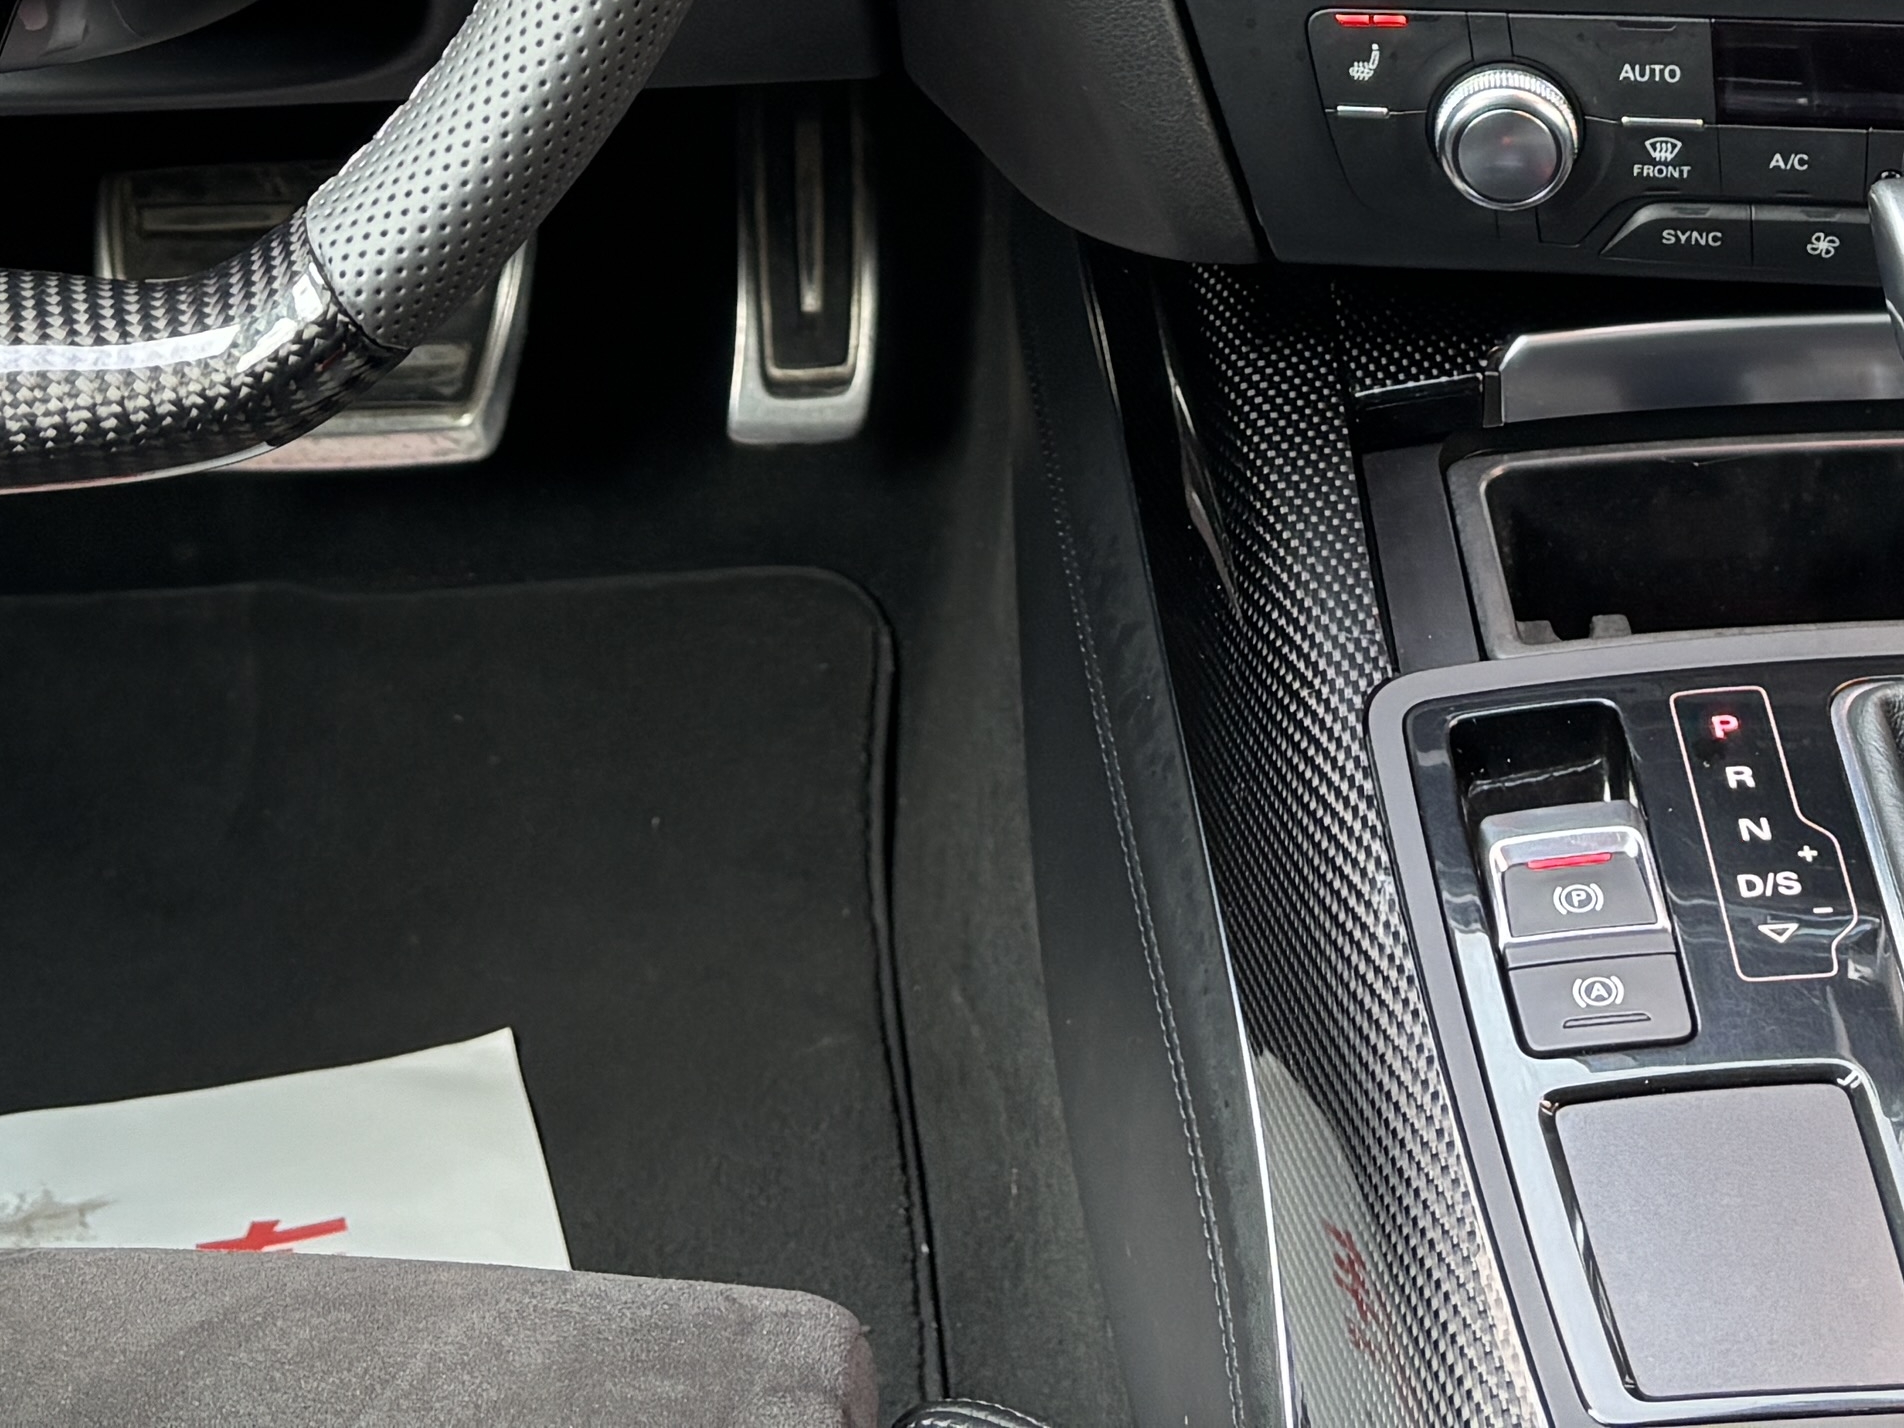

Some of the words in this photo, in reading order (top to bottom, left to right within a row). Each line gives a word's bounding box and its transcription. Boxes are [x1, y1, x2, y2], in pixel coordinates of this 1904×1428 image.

[1618, 63, 1681, 84] AUTO
[1632, 163, 1691, 179] FRONT
[1769, 152, 1809, 171] A/C
[1661, 229, 1723, 247] SYNC
[1711, 713, 1739, 740] P
[1725, 765, 1756, 789] R
[1738, 816, 1773, 842] N
[1736, 870, 1802, 898] D/S
